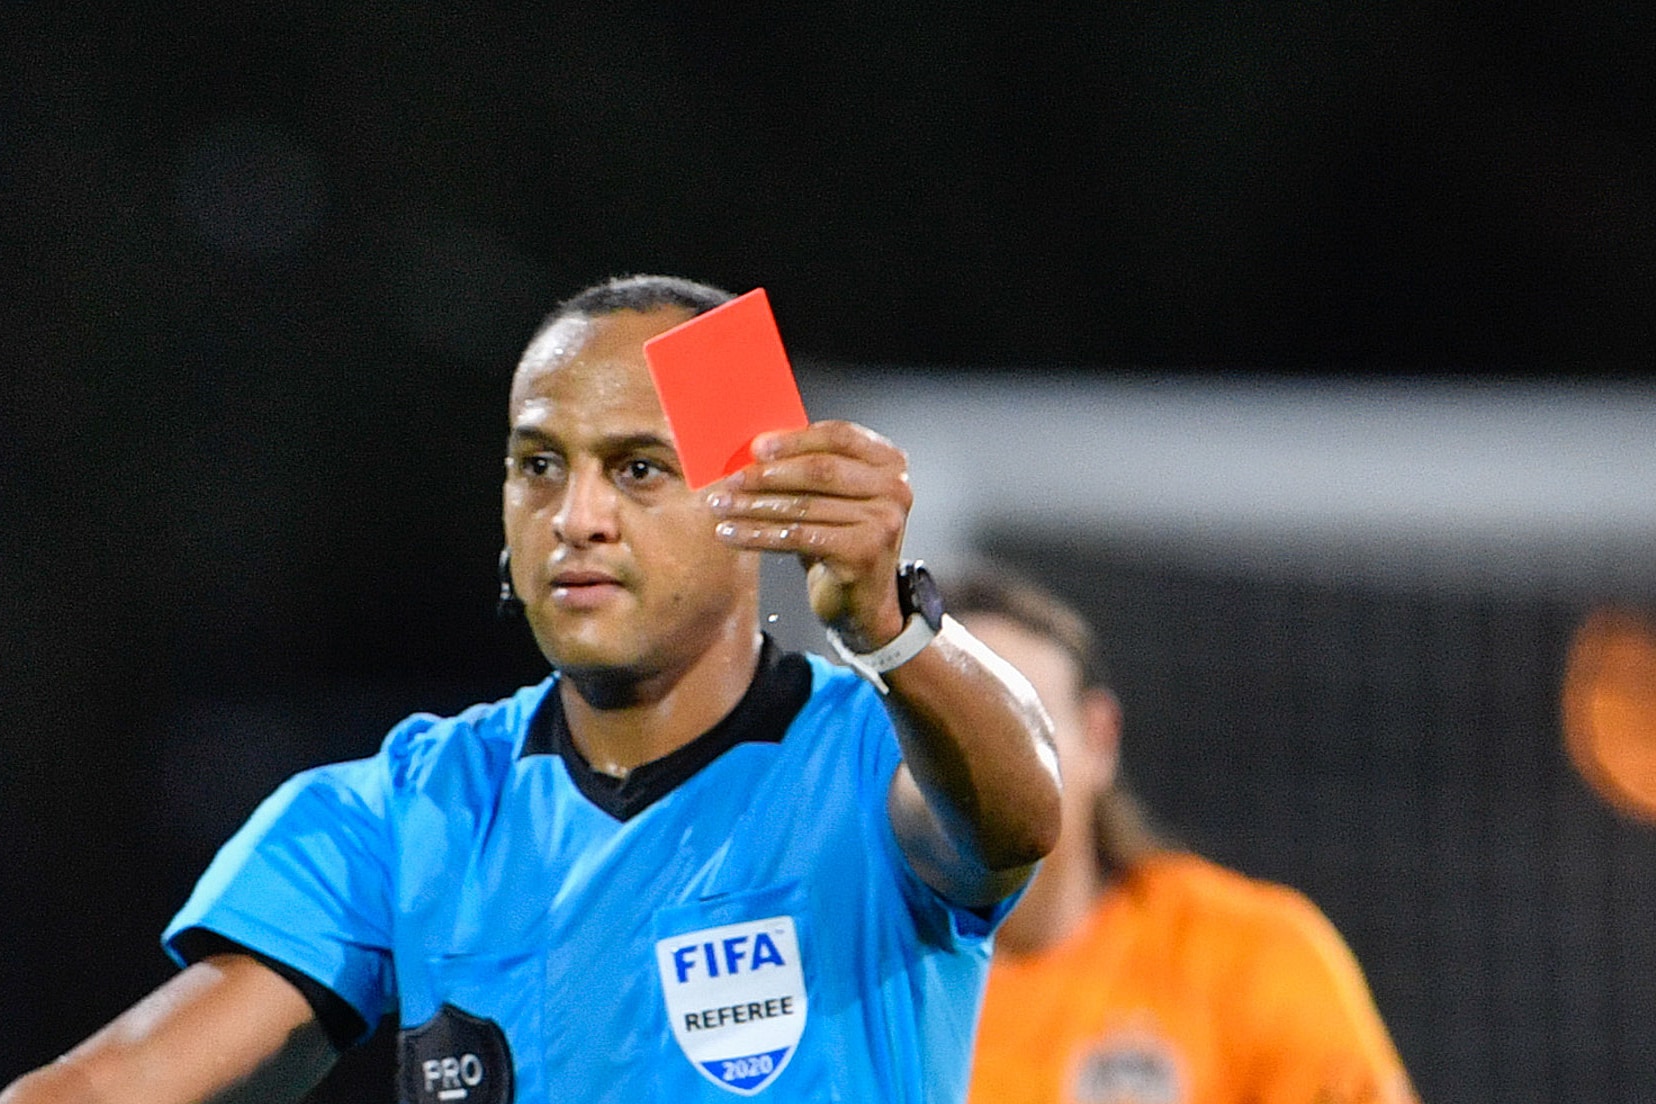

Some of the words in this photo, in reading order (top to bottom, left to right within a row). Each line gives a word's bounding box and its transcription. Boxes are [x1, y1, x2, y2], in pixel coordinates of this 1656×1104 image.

[672, 932, 785, 983] FIFA
[684, 996, 794, 1031] REFEREE
[422, 1053, 483, 1092] PRO
[722, 1055, 773, 1081] 2020
